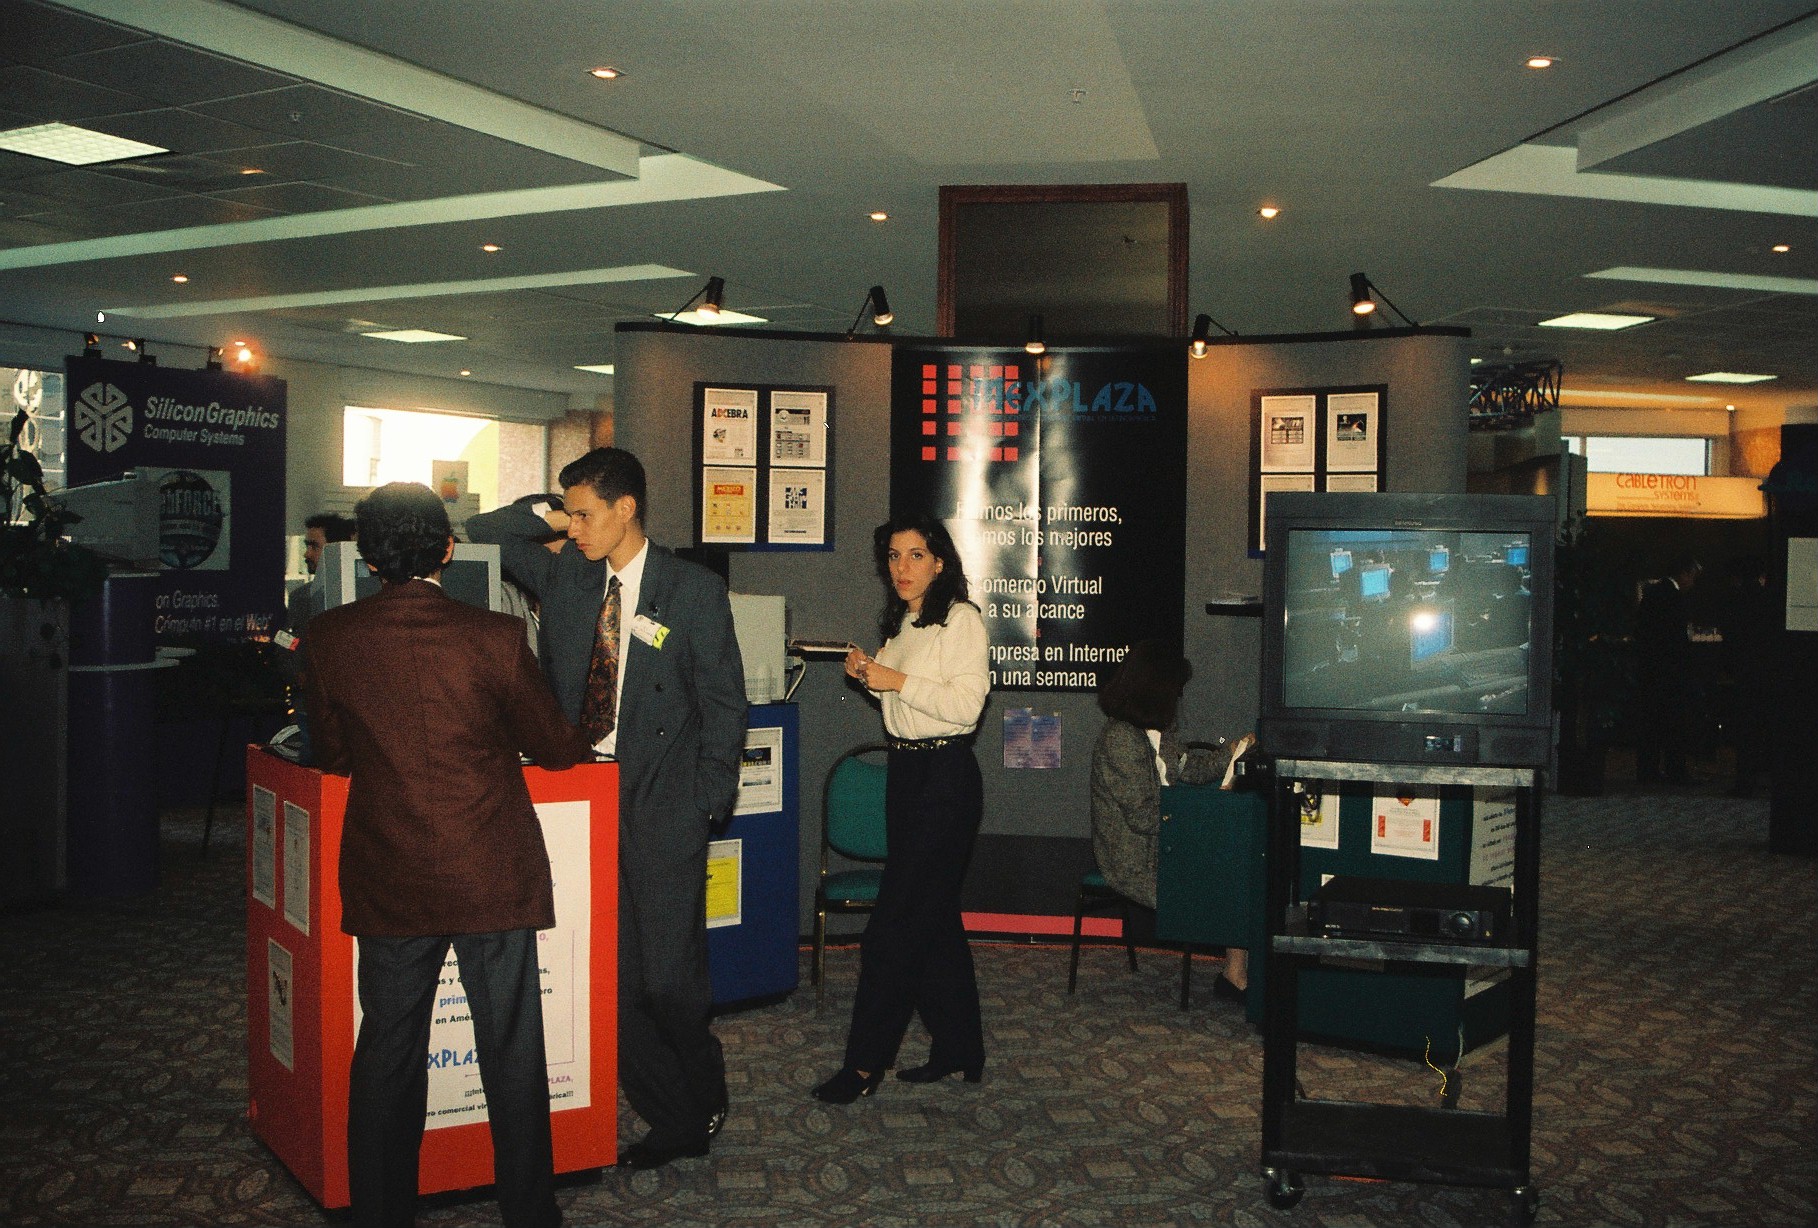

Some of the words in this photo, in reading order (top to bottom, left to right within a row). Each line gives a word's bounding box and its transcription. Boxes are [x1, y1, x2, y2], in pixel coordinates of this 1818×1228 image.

[144, 423, 198, 443] Computer
[200, 428, 246, 447] Systems
[1019, 501, 1042, 520] los
[1047, 503, 1122, 525] primeros,
[1021, 526, 1044, 546] los
[1050, 527, 1112, 550] mejores
[974, 577, 1046, 594] omercio
[1051, 575, 1102, 595] Virtual
[155, 594, 169, 609] on
[988, 602, 997, 618] a
[1002, 602, 1020, 618] su
[989, 645, 1040, 664] mpresa
[1044, 645, 1064, 662] en
[989, 669, 997, 685] n
[1002, 670, 1031, 686] una
[1036, 671, 1097, 687] semana
[439, 994, 467, 1008] prim
[435, 1017, 447, 1025] en
[427, 1048, 479, 1070] XPLA
[437, 1105, 475, 1116] comercial
[477, 1102, 488, 1110] vir
